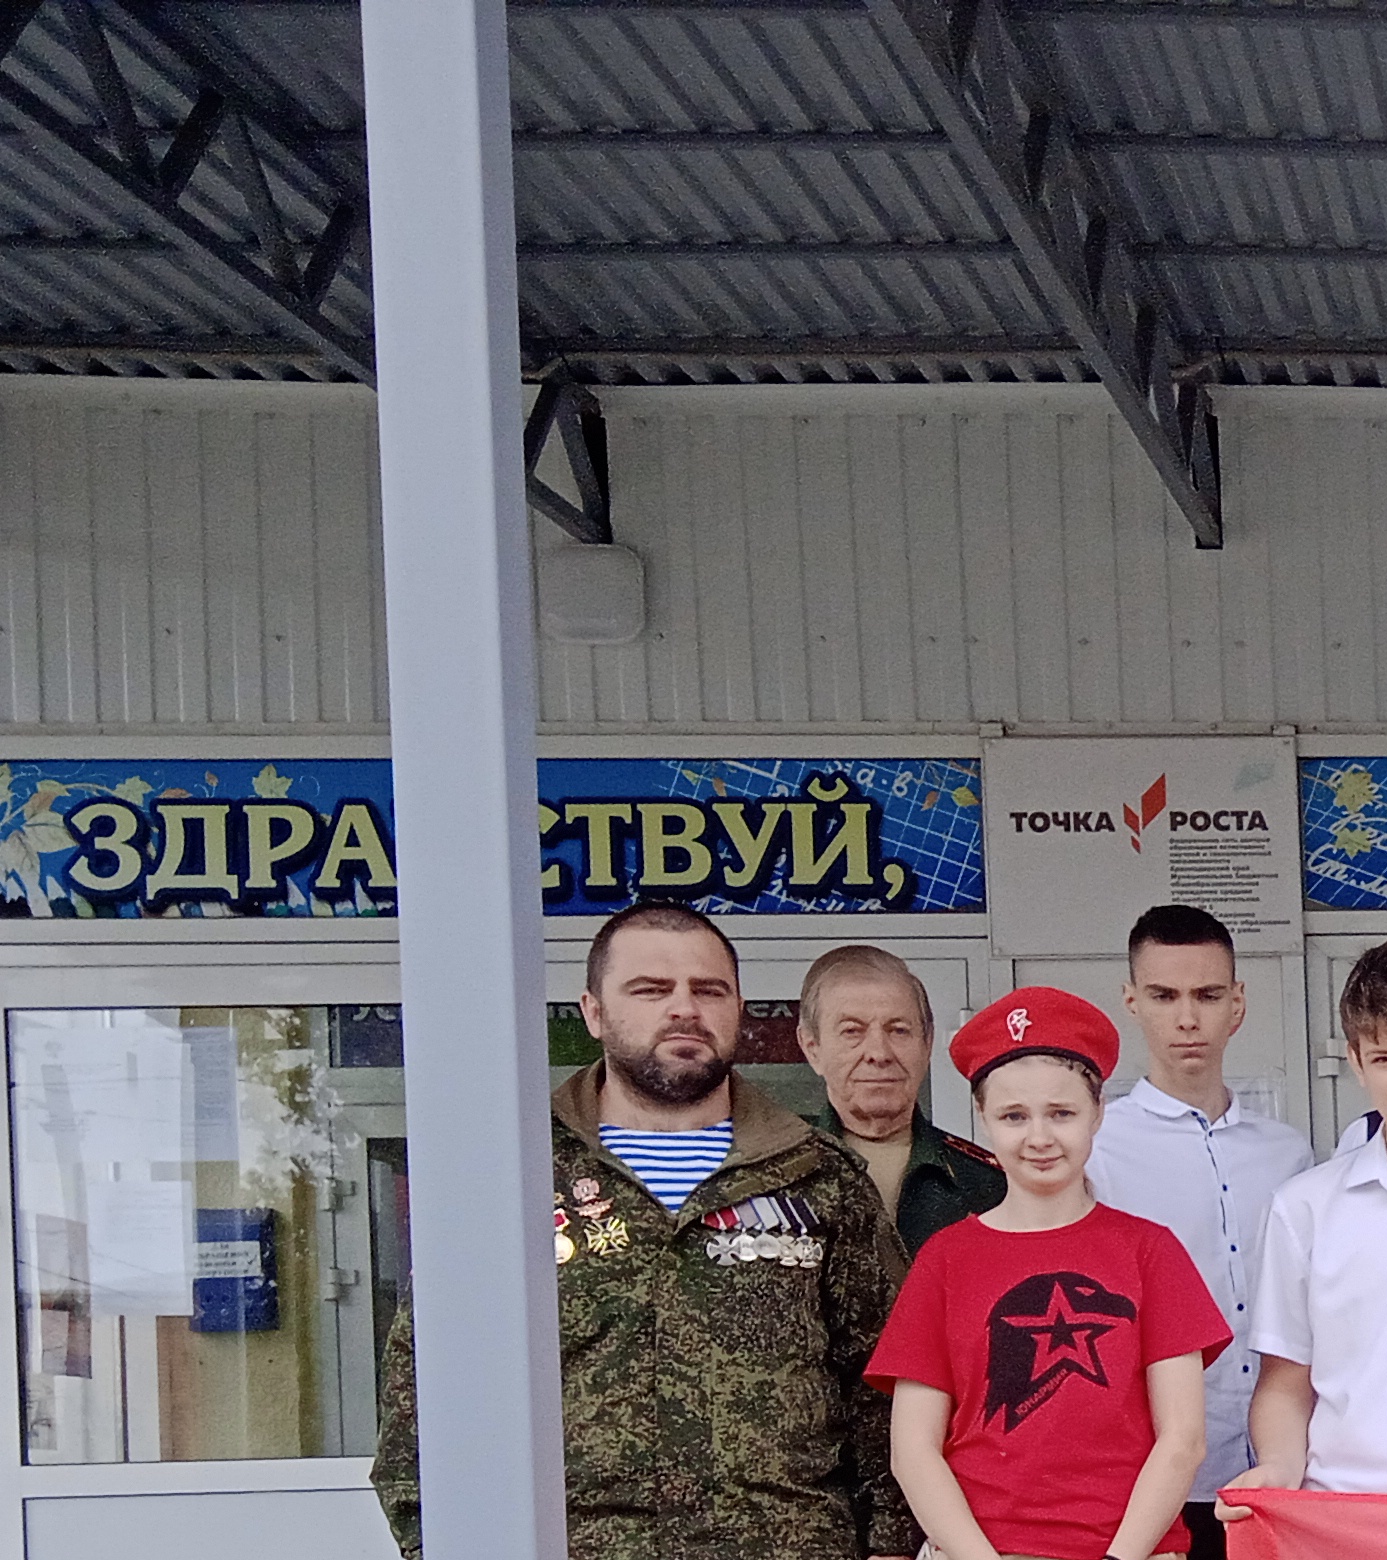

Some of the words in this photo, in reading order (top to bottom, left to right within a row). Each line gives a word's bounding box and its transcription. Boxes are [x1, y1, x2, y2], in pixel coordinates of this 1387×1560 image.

[70, 776, 906, 901] ЗДРАТВУЙ,
[1009, 811, 1116, 833] ТОЧКА
[1169, 810, 1269, 832] РОСТА
